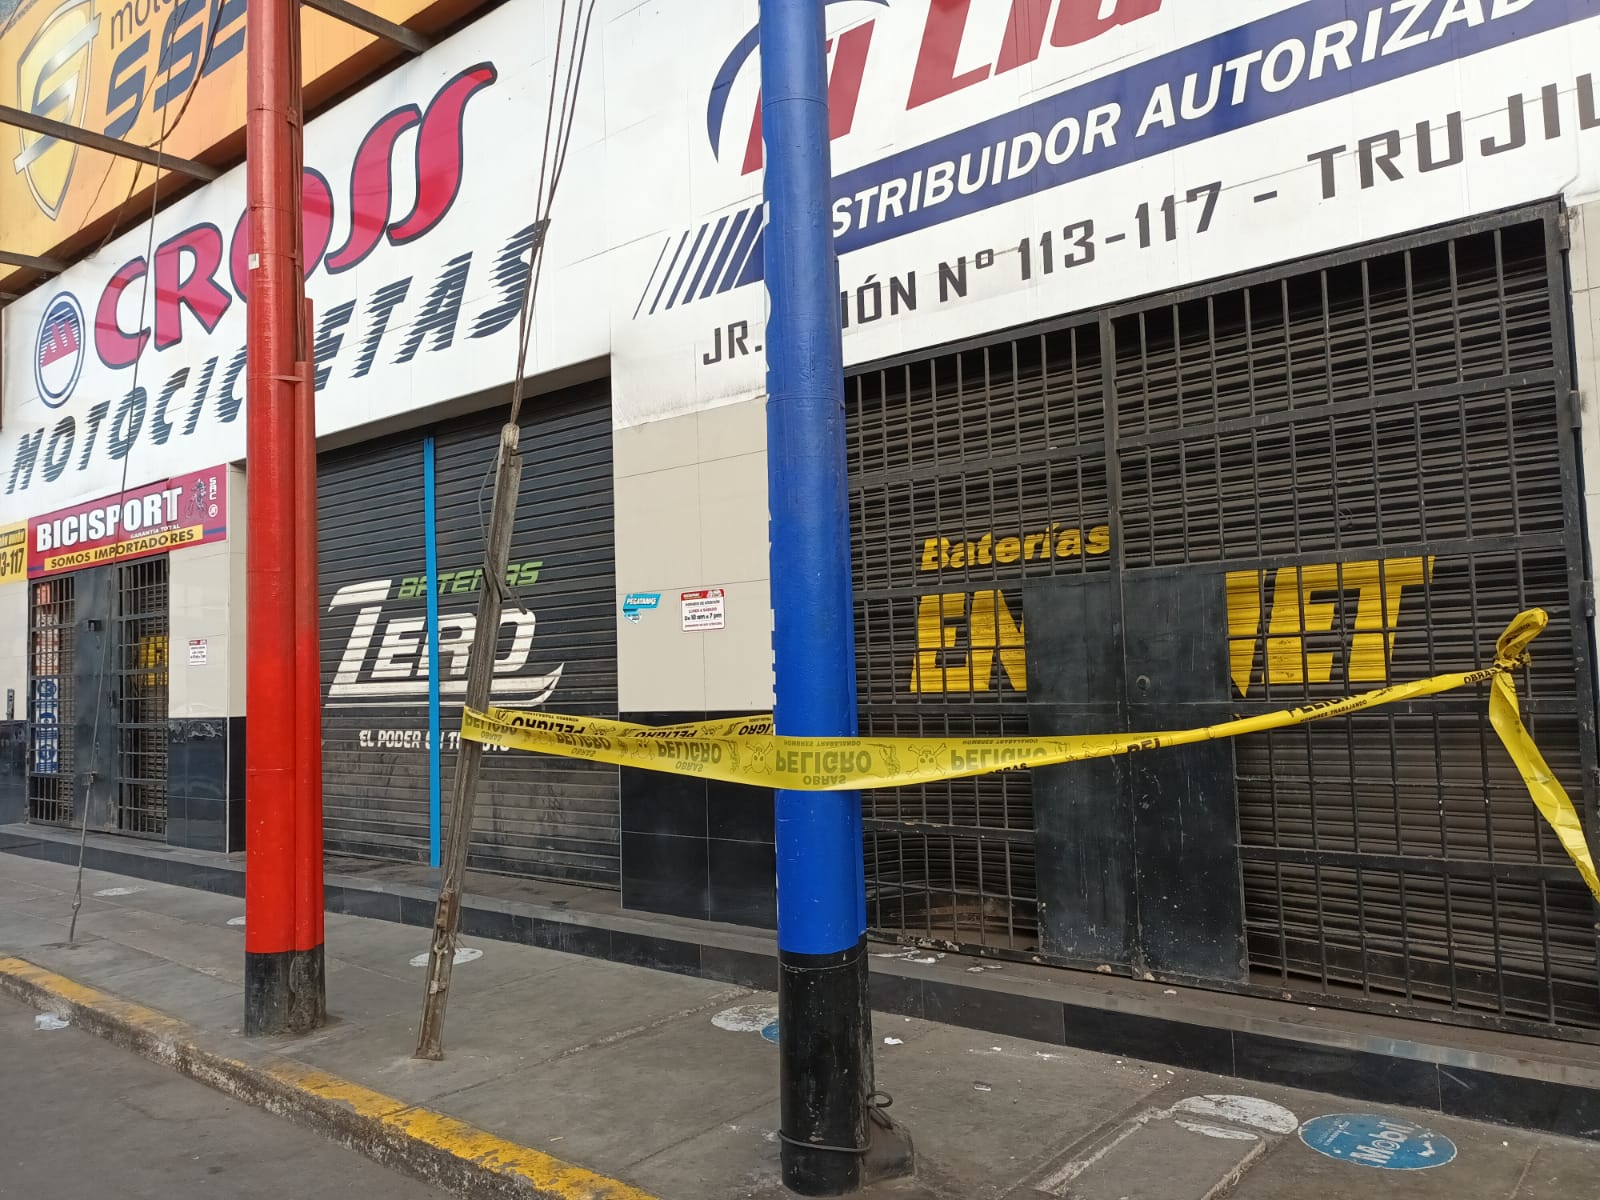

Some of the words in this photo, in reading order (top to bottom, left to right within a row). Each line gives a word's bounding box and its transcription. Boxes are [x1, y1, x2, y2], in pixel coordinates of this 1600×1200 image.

[831, 102, 1121, 239] STRIBUIDOR
[702, 320, 763, 366] JR.
[1016, 180, 1223, 282] 113-117
[1307, 73, 1600, 200] TRUJIL
[4, 218, 551, 495] MOTOCICETAS
[36, 486, 183, 553] BICISPORT
[0, 547, 25, 577] 3-117
[51, 552, 91, 569] SOMOS
[94, 529, 195, 560] IMPORTADORES
[920, 523, 1112, 572] Baterías
[359, 730, 374, 748] EL
[377, 730, 421, 749] PODER
[1350, 1121, 1415, 1164] Mobil
